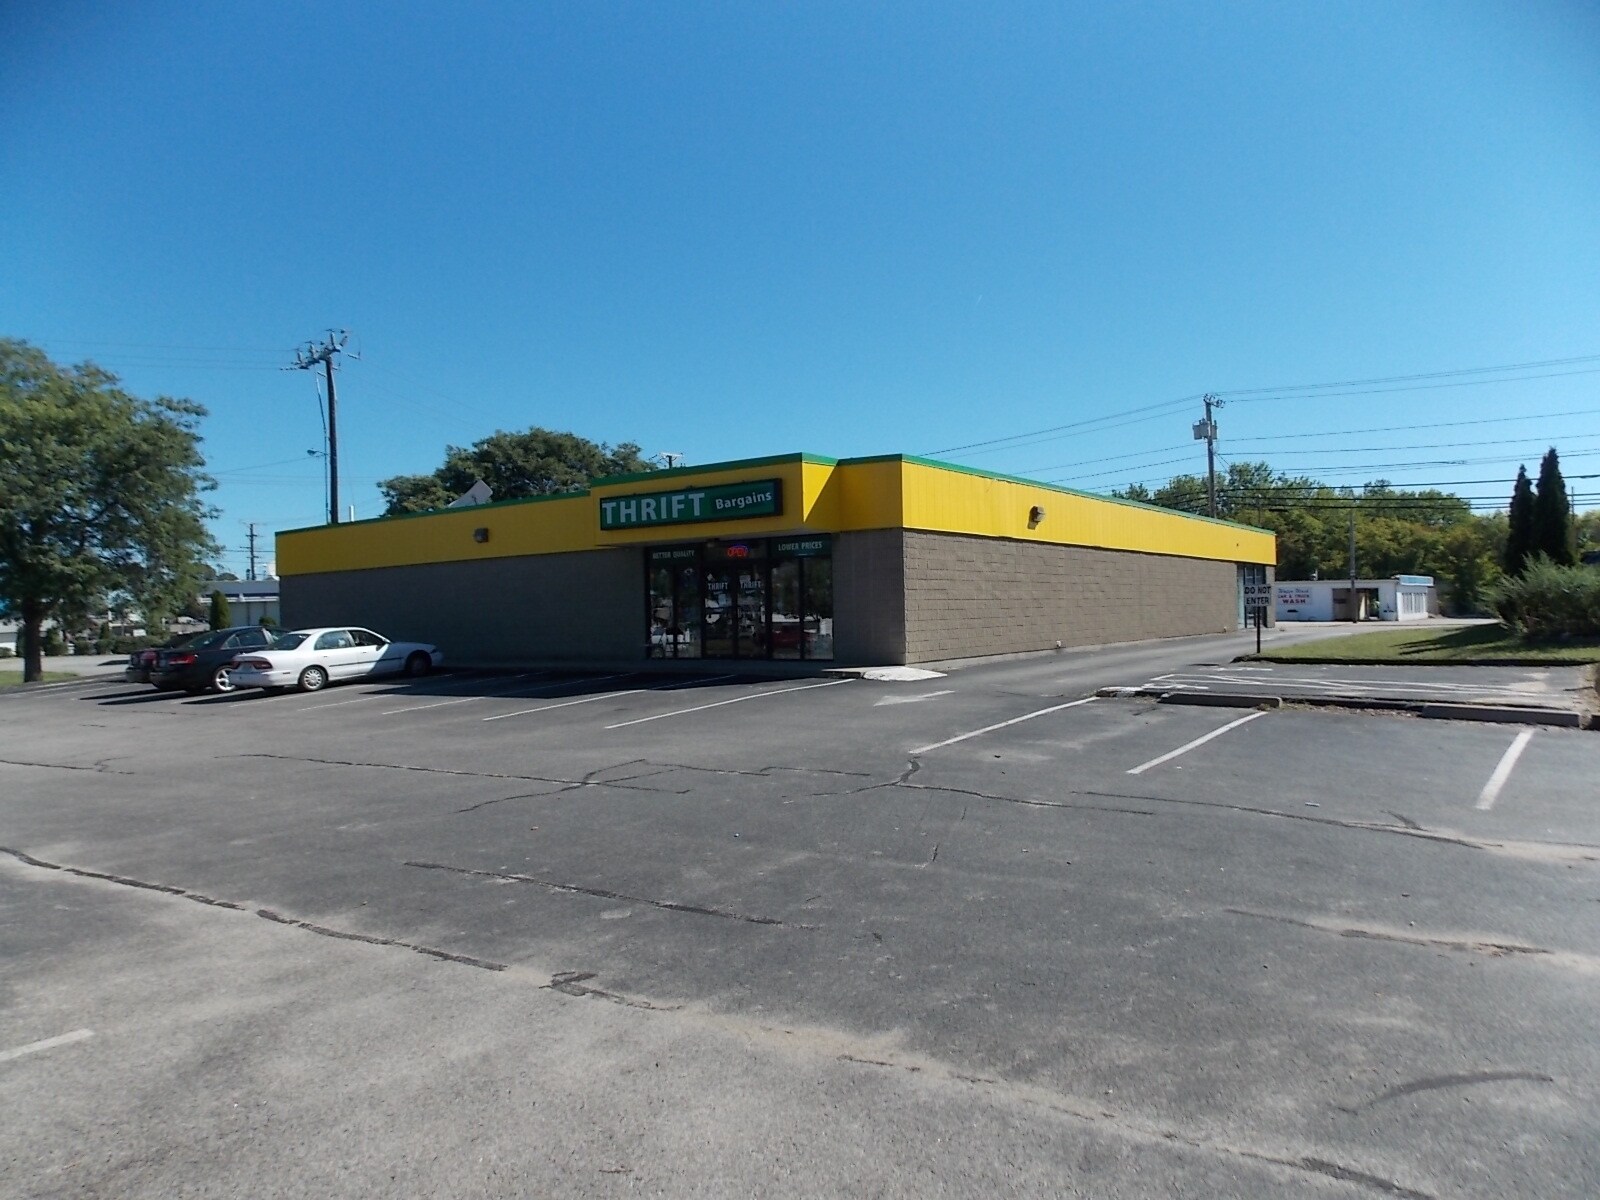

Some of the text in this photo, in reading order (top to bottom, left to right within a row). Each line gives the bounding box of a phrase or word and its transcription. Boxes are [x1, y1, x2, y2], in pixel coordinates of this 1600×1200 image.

[602, 491, 773, 524] THRIFT Bargains
[778, 541, 823, 552] LOWER PRICES
[727, 547, 749, 559] OPEN
[708, 582, 729, 590] THRIFT
[1244, 586, 1256, 594] DO
[1257, 586, 1271, 594] NOT
